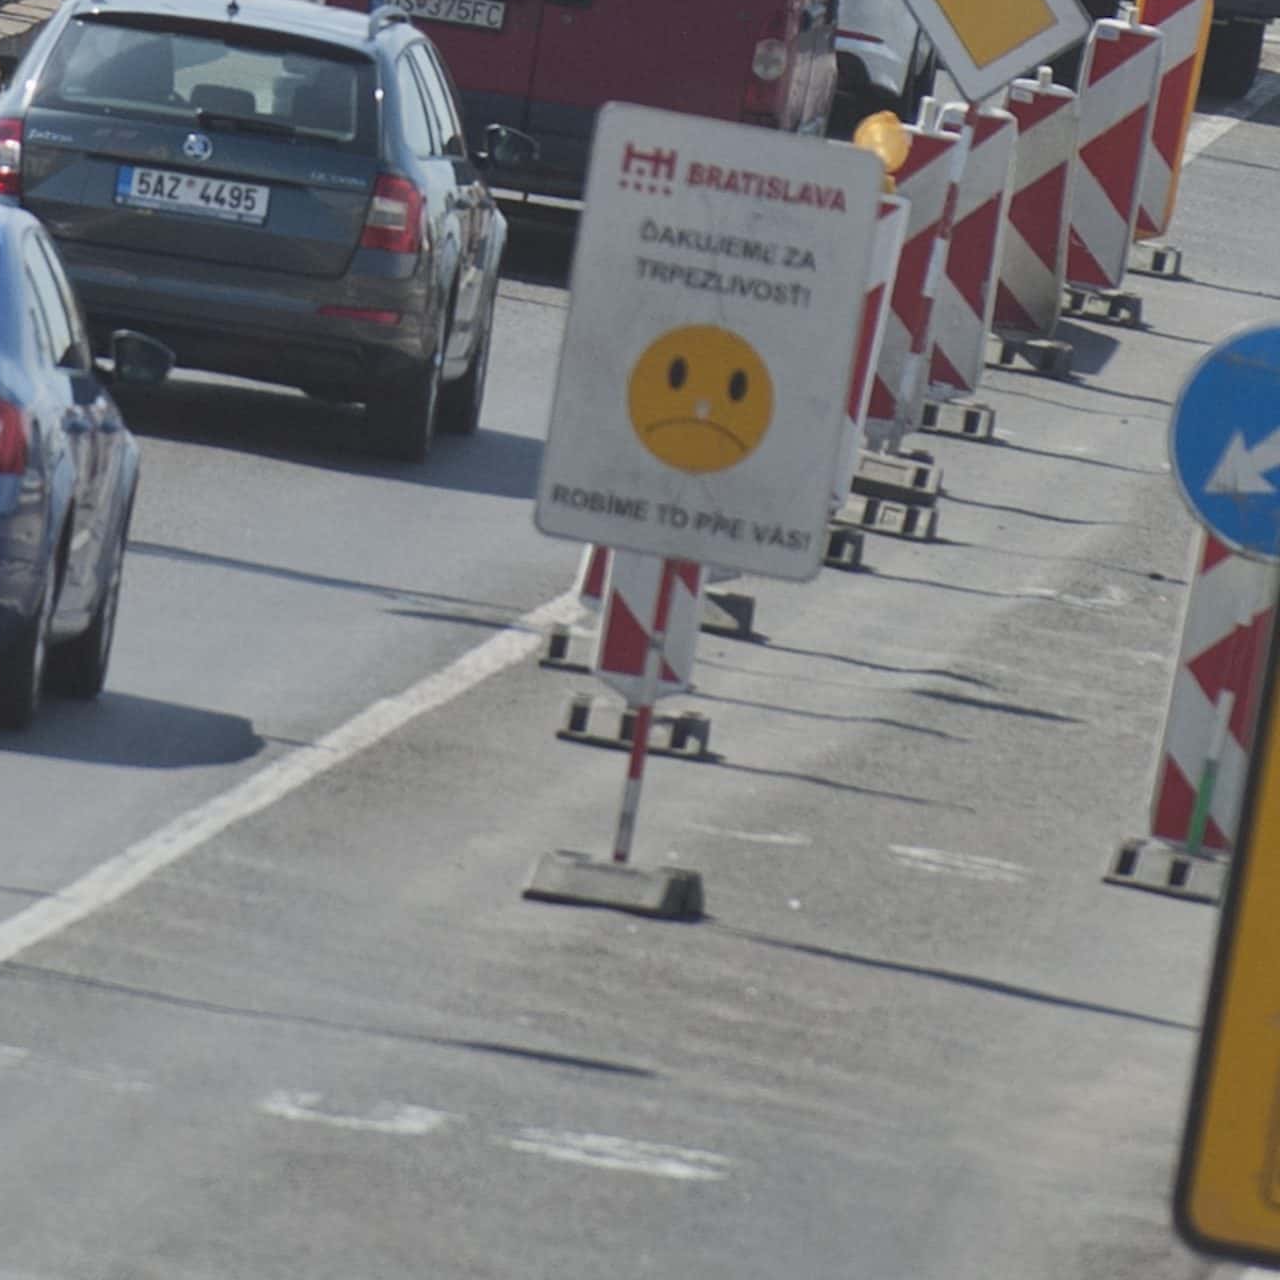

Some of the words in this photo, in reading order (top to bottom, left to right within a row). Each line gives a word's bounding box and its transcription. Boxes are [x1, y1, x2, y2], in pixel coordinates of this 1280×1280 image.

[137, 172, 182, 200] 5AZ
[199, 182, 258, 211] 4495
[686, 161, 847, 212] BRATISLAVA
[782, 244, 816, 271] ZA
[656, 501, 689, 529] TO
